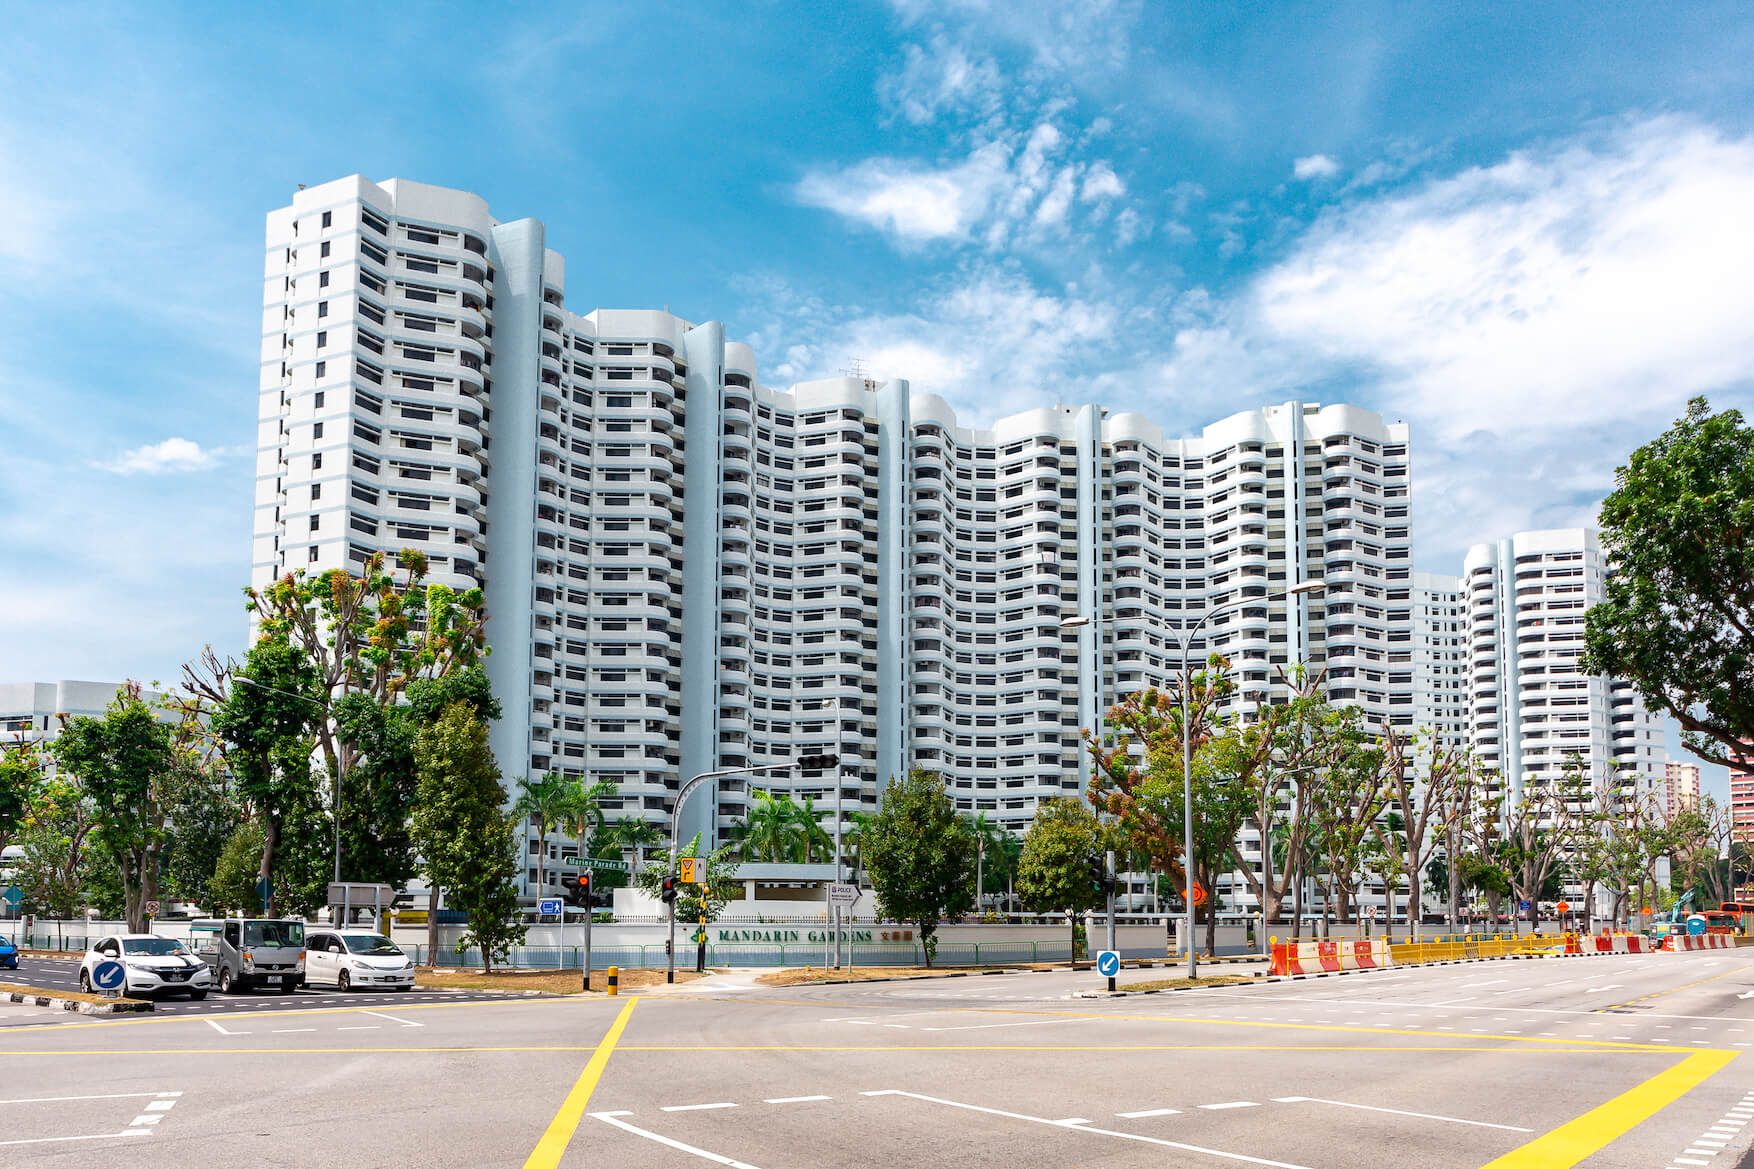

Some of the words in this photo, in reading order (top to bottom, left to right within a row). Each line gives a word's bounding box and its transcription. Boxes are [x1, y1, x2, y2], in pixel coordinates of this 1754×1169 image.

[569, 858, 593, 866] Marine
[594, 860, 616, 868] Parade
[618, 861, 627, 869] Rd
[719, 930, 798, 941] MANDARIN
[808, 930, 872, 941] GARDENS
